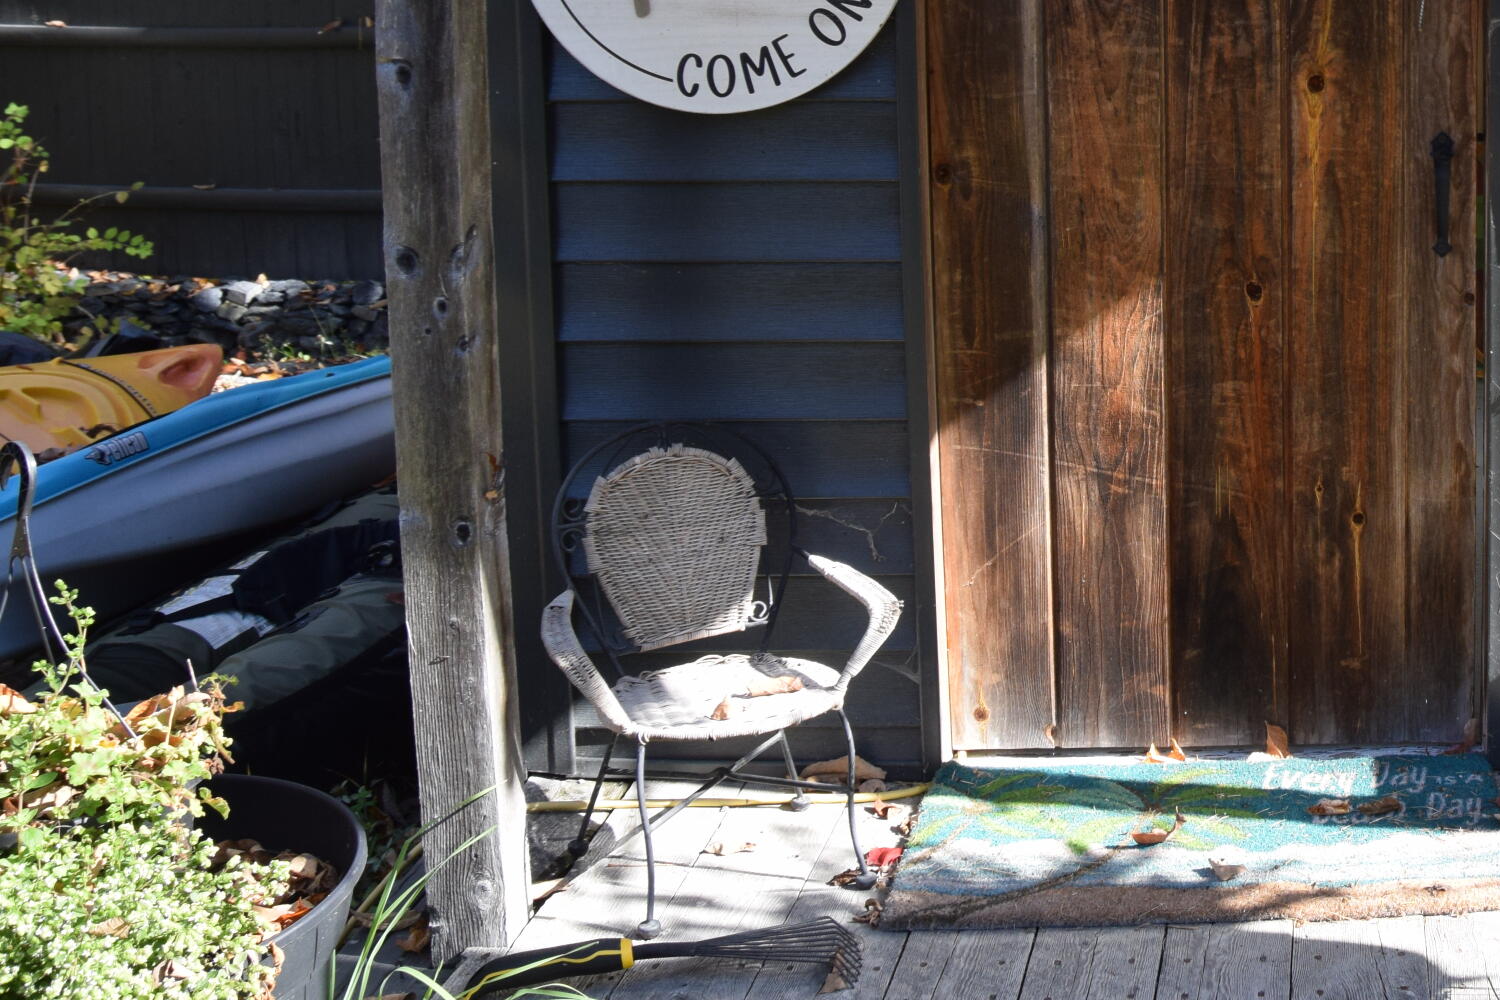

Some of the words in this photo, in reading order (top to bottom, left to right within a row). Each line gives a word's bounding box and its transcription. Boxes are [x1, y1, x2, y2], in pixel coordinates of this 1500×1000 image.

[676, 33, 808, 98] COME
[92, 431, 149, 465] Pelican
[1262, 762, 1357, 797] Every
[1426, 791, 1482, 825] Day
